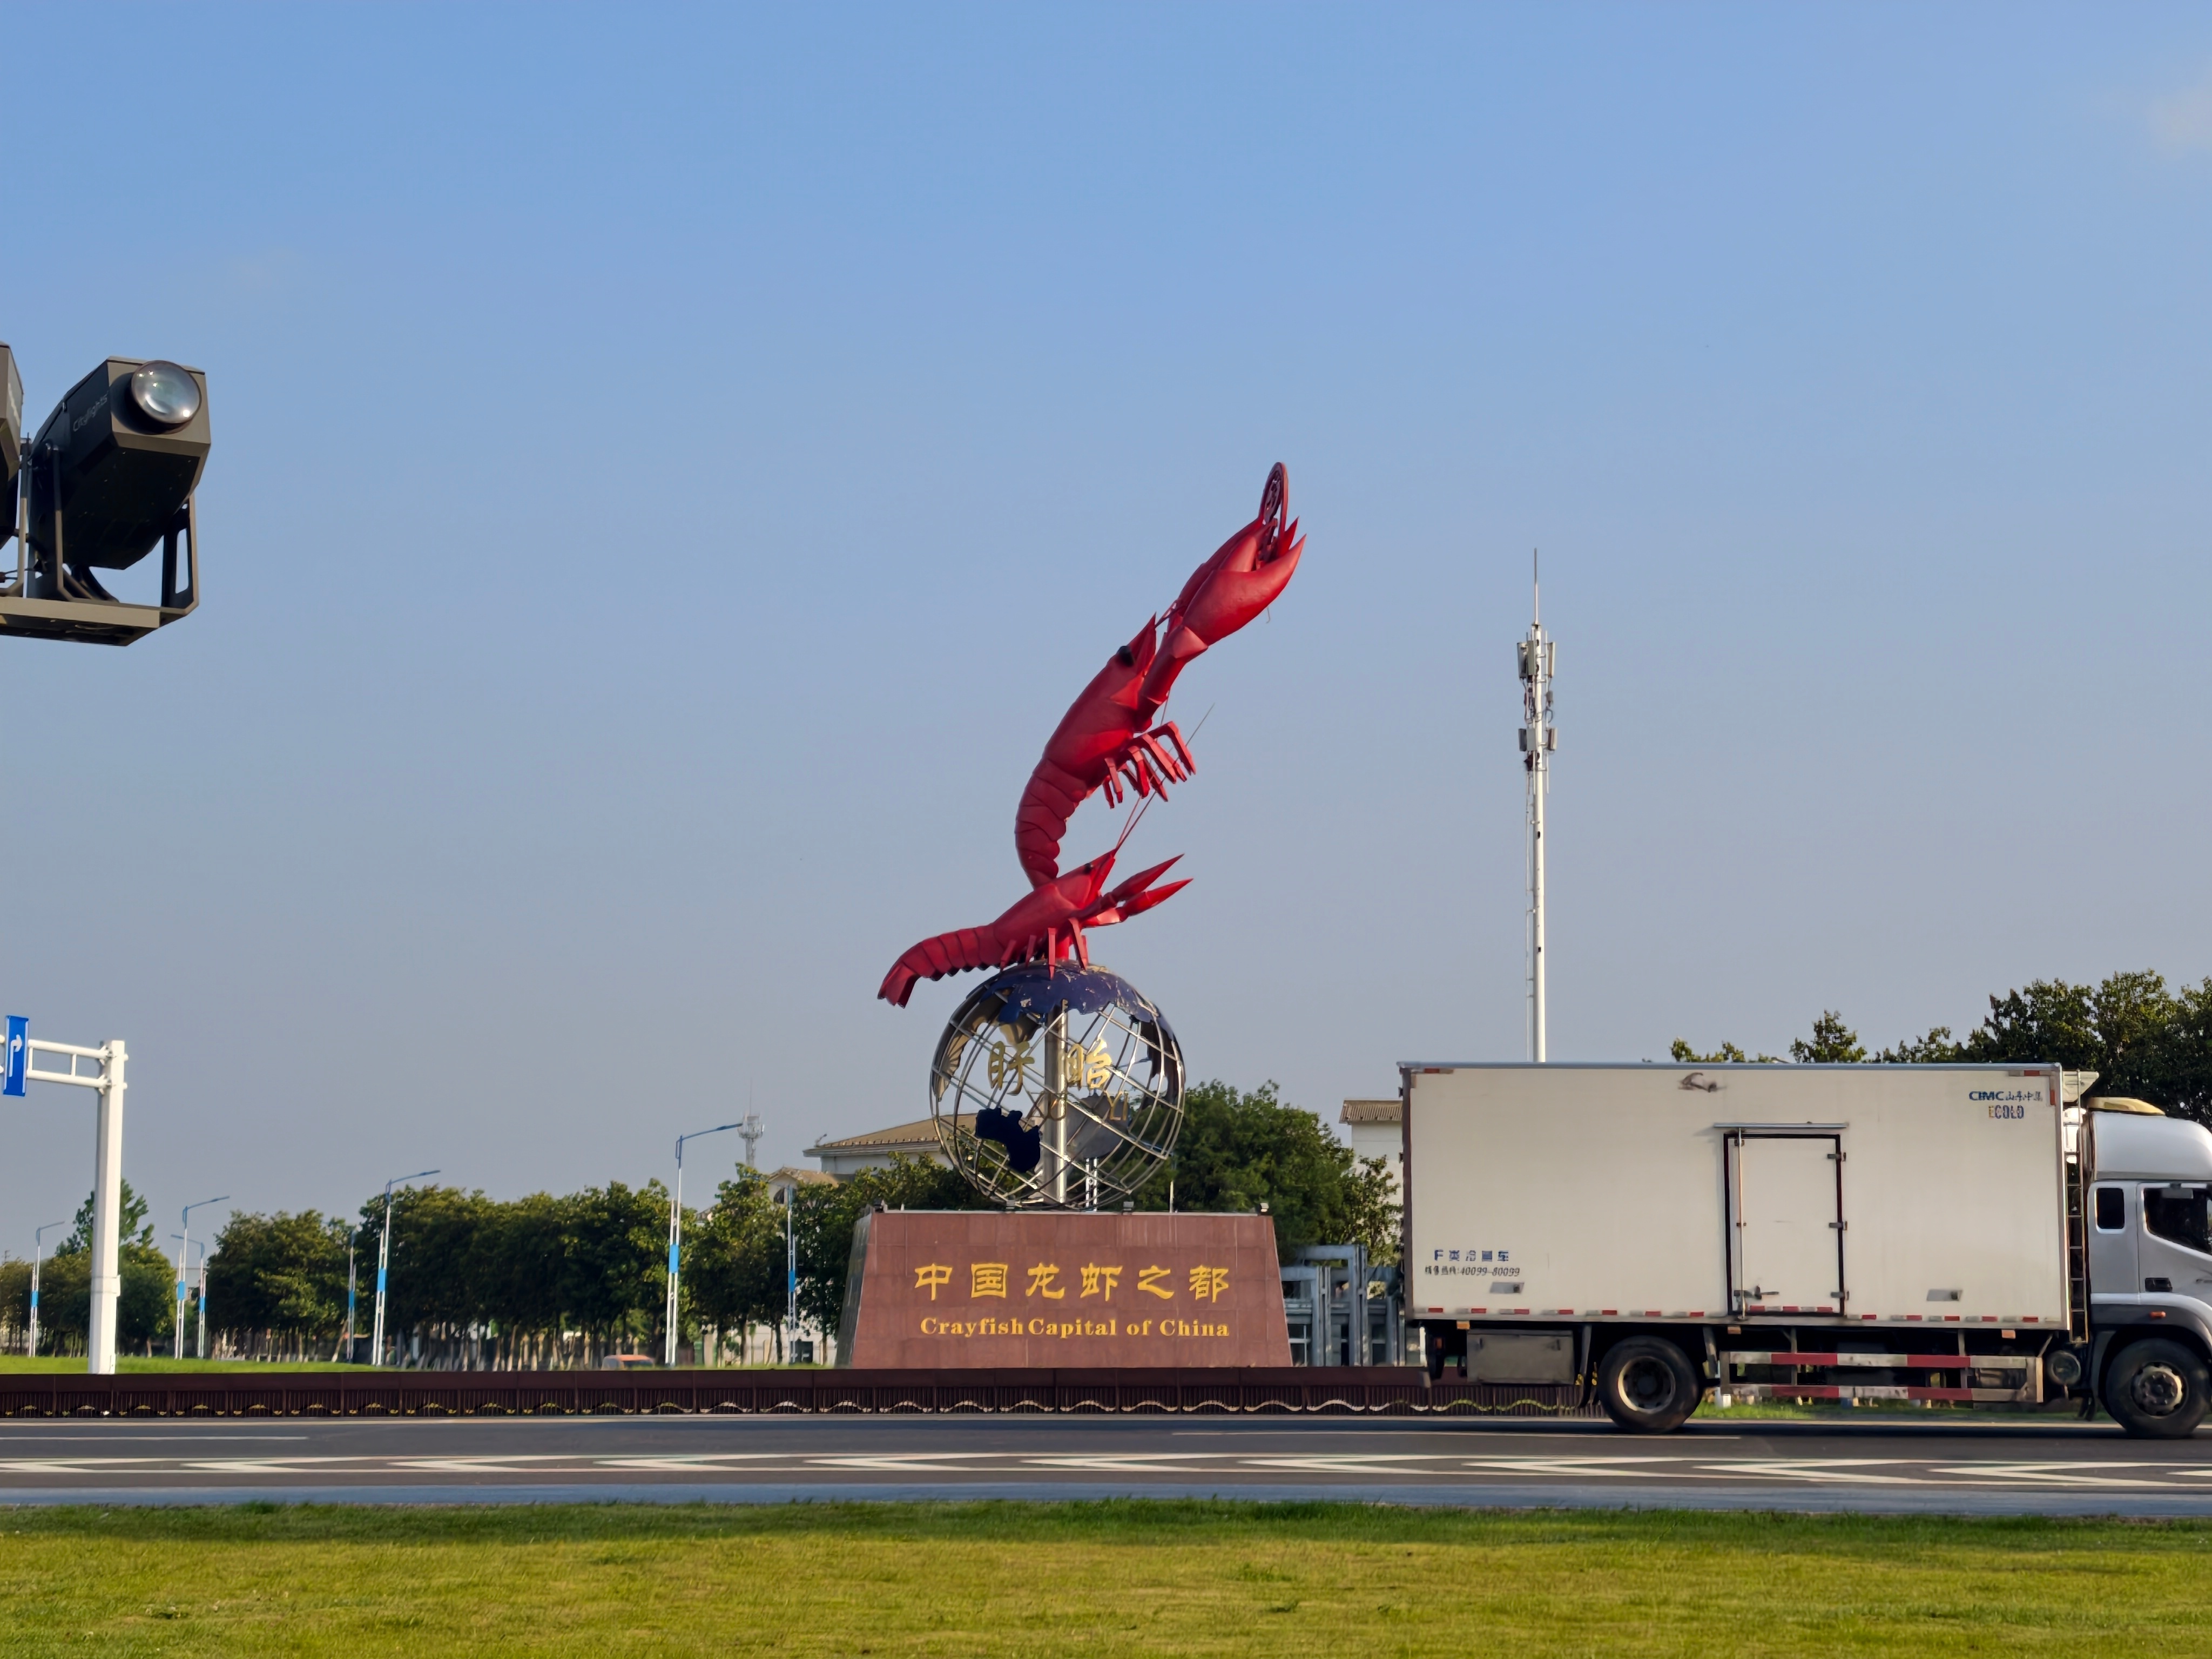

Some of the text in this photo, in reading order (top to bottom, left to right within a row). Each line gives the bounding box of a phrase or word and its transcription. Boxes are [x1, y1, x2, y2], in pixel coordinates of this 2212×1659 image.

[914, 1262, 1230, 1303] 中国龙虾之都
[920, 1318, 1229, 1339] Crayfish Capital of China
